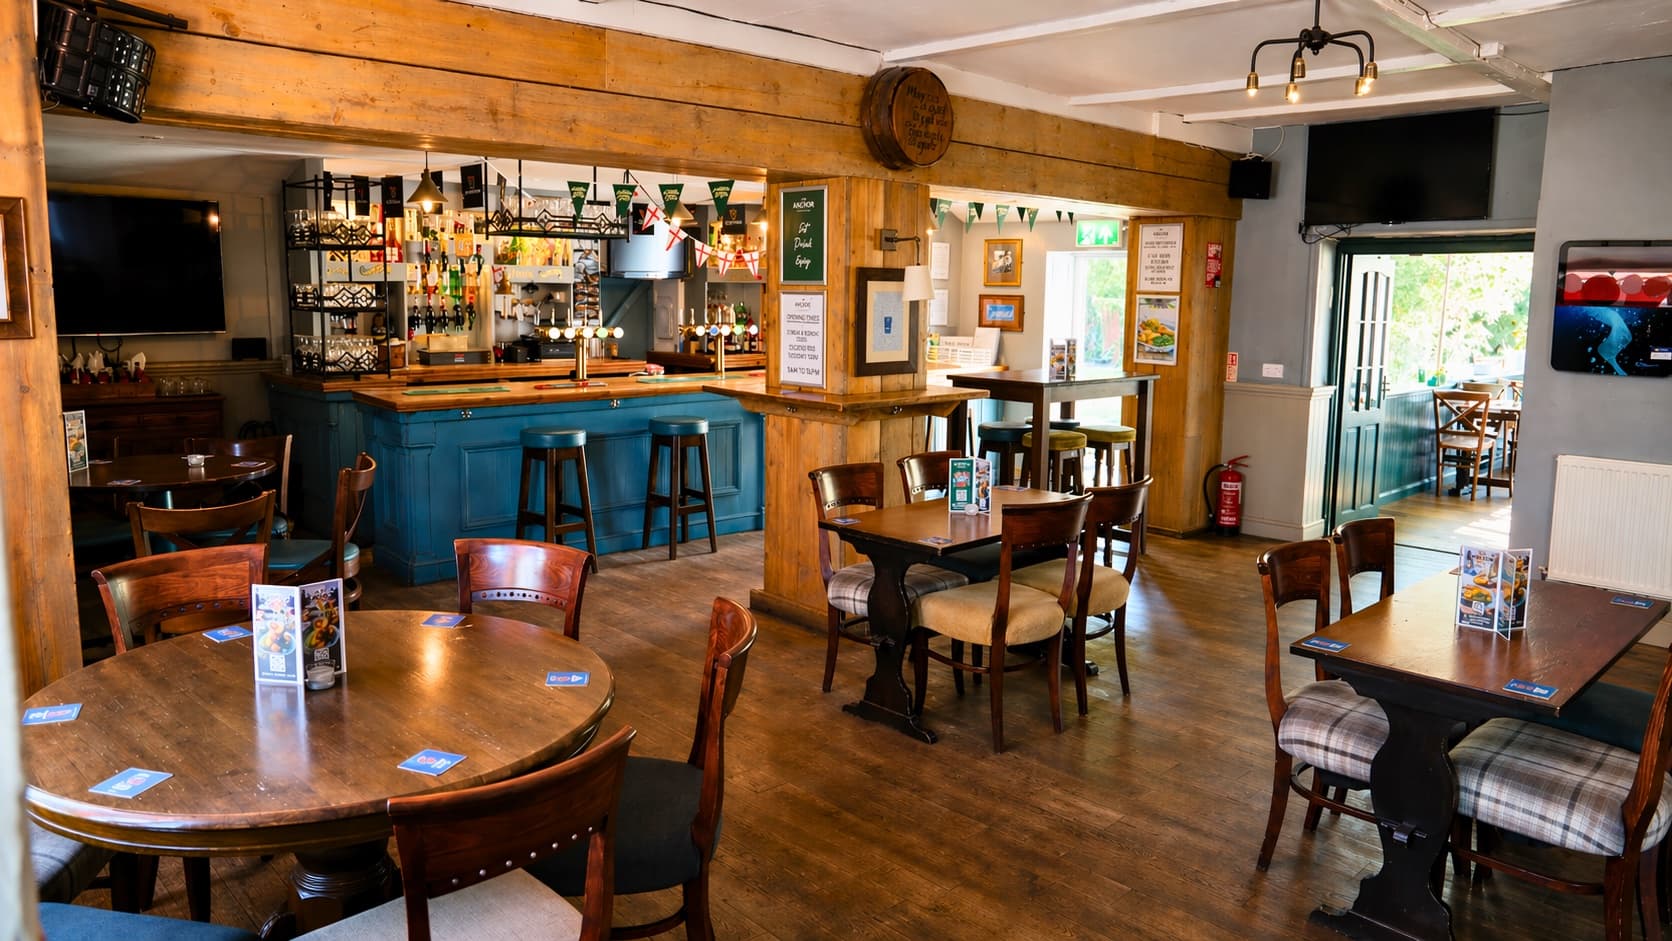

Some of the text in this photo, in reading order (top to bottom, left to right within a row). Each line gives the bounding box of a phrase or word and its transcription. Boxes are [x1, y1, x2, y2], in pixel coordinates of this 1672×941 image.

[793, 201, 815, 209] ANCHOR
[794, 237, 813, 251] Drink
[795, 254, 811, 270] Enjoy
